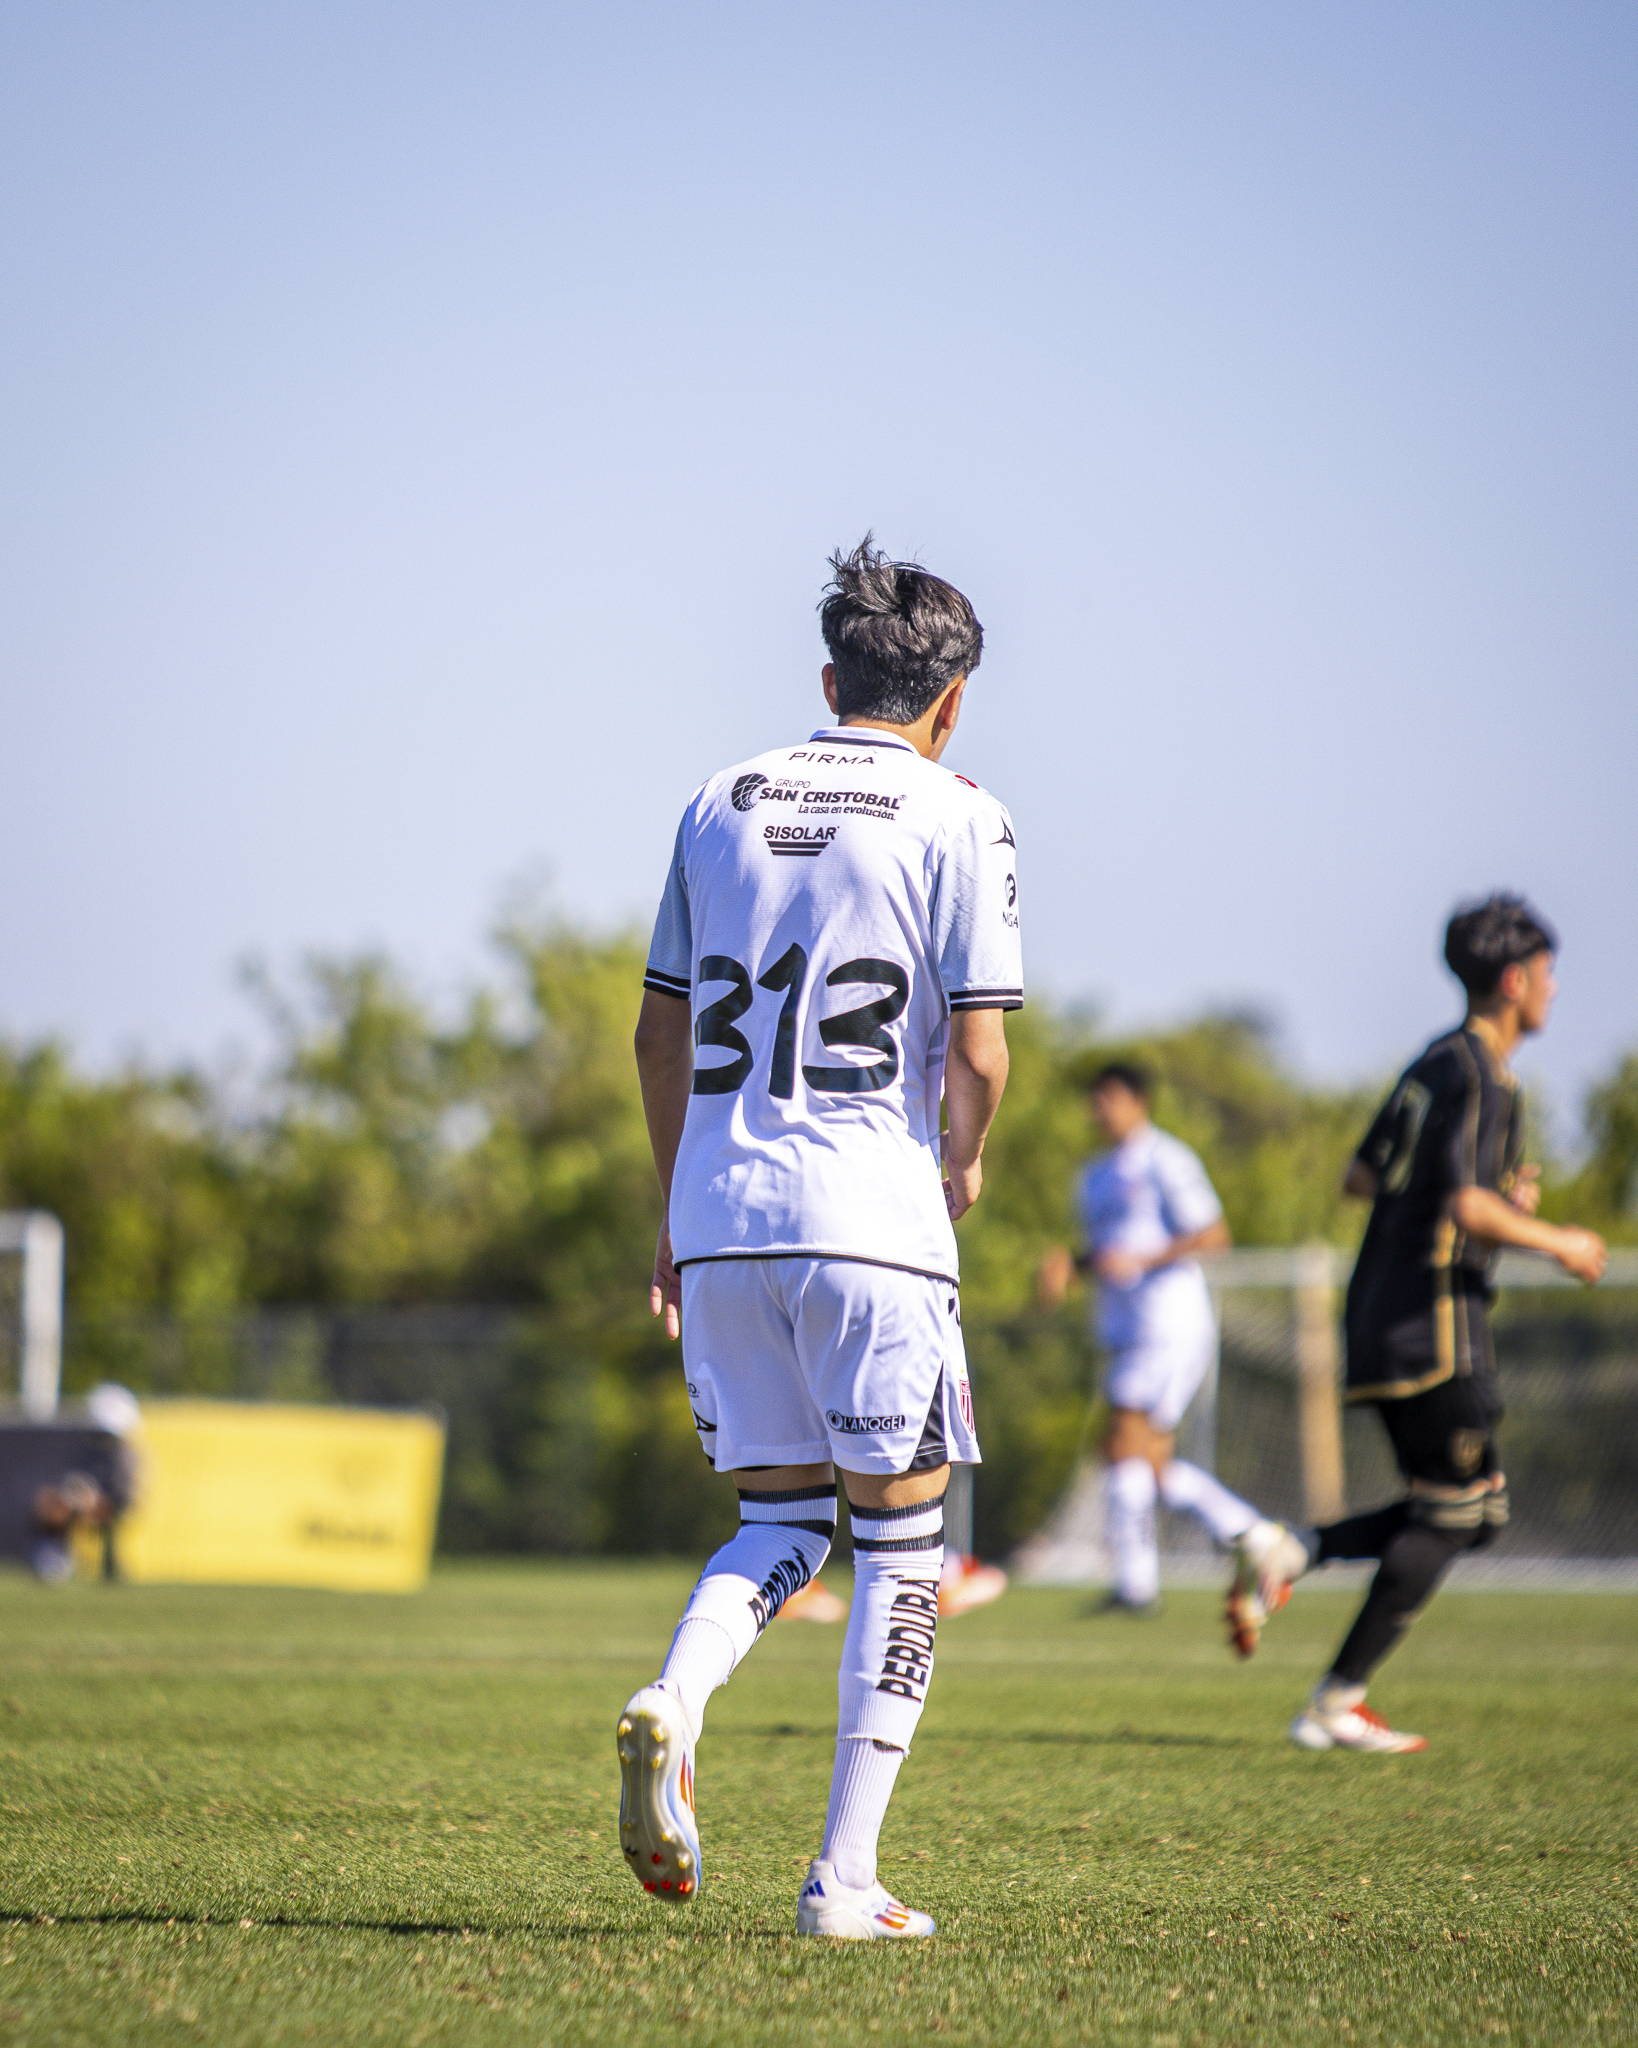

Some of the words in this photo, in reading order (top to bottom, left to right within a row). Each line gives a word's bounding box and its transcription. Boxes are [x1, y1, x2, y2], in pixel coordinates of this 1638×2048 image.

[788, 752, 875, 765] PIRMA
[775, 778, 811, 789] GRUPO
[759, 787, 799, 802] SAN
[798, 804, 809, 814] La
[810, 805, 829, 814] casa
[830, 805, 842, 814] en
[763, 825, 837, 841] SISOLAR
[693, 943, 909, 1100] 313
